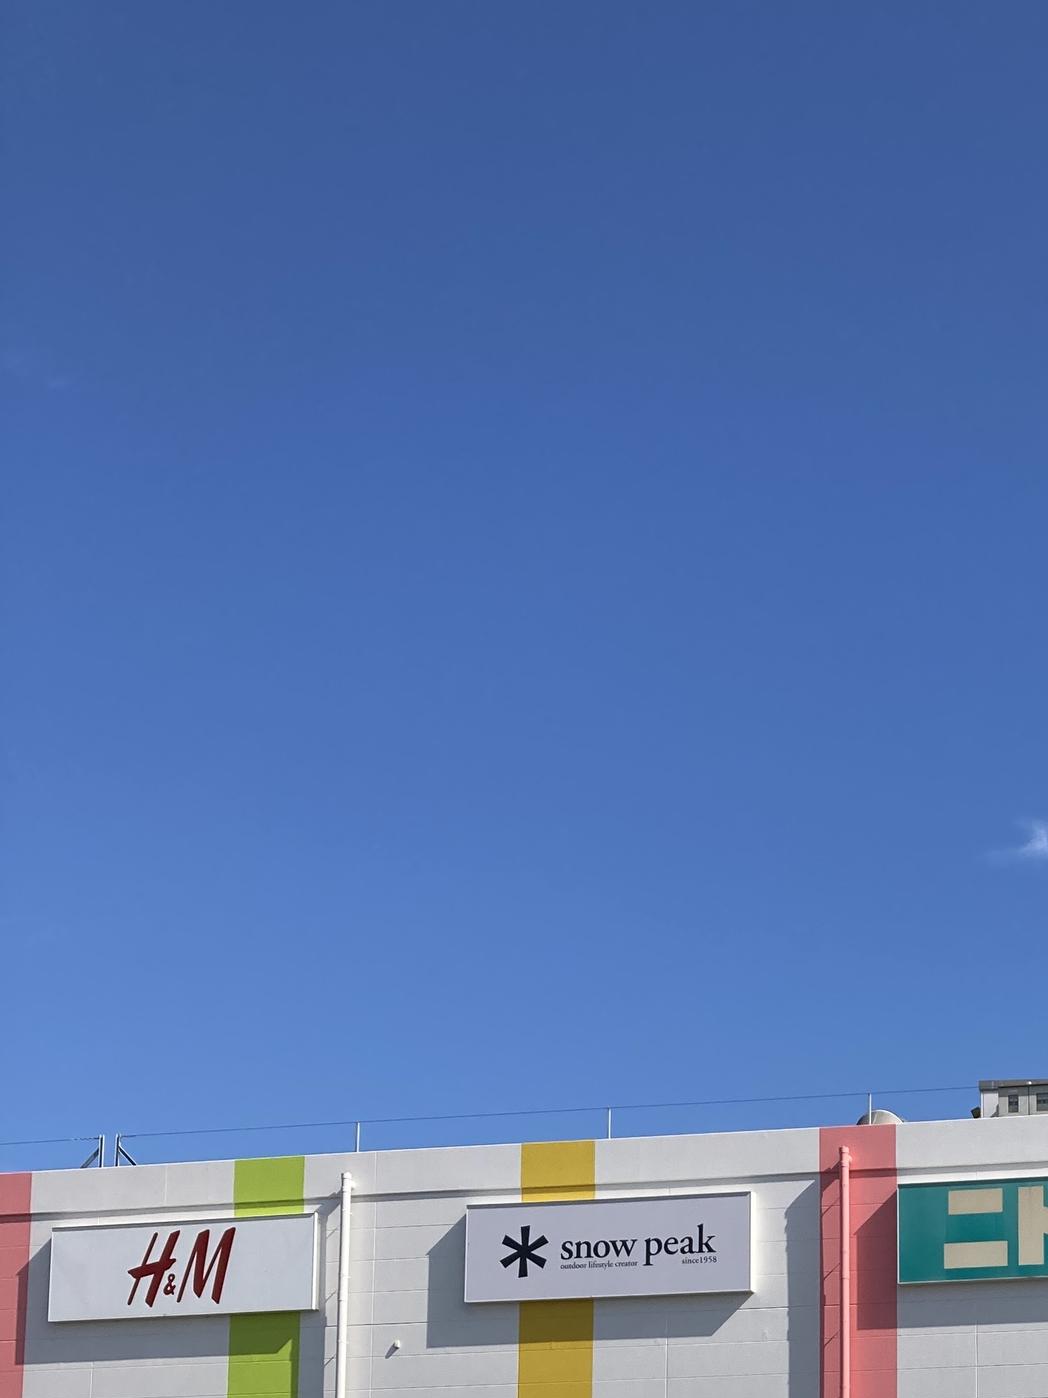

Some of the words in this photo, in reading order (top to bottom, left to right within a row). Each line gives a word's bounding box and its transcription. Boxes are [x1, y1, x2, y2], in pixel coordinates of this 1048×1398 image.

[560, 1238, 638, 1260] snow
[642, 1223, 717, 1266] peak
[127, 1227, 236, 1307] H&M
[560, 1262, 587, 1270] outdoor
[588, 1260, 614, 1271] lifestyle
[614, 1260, 638, 1268] creator
[681, 1255, 718, 1265] since1958
